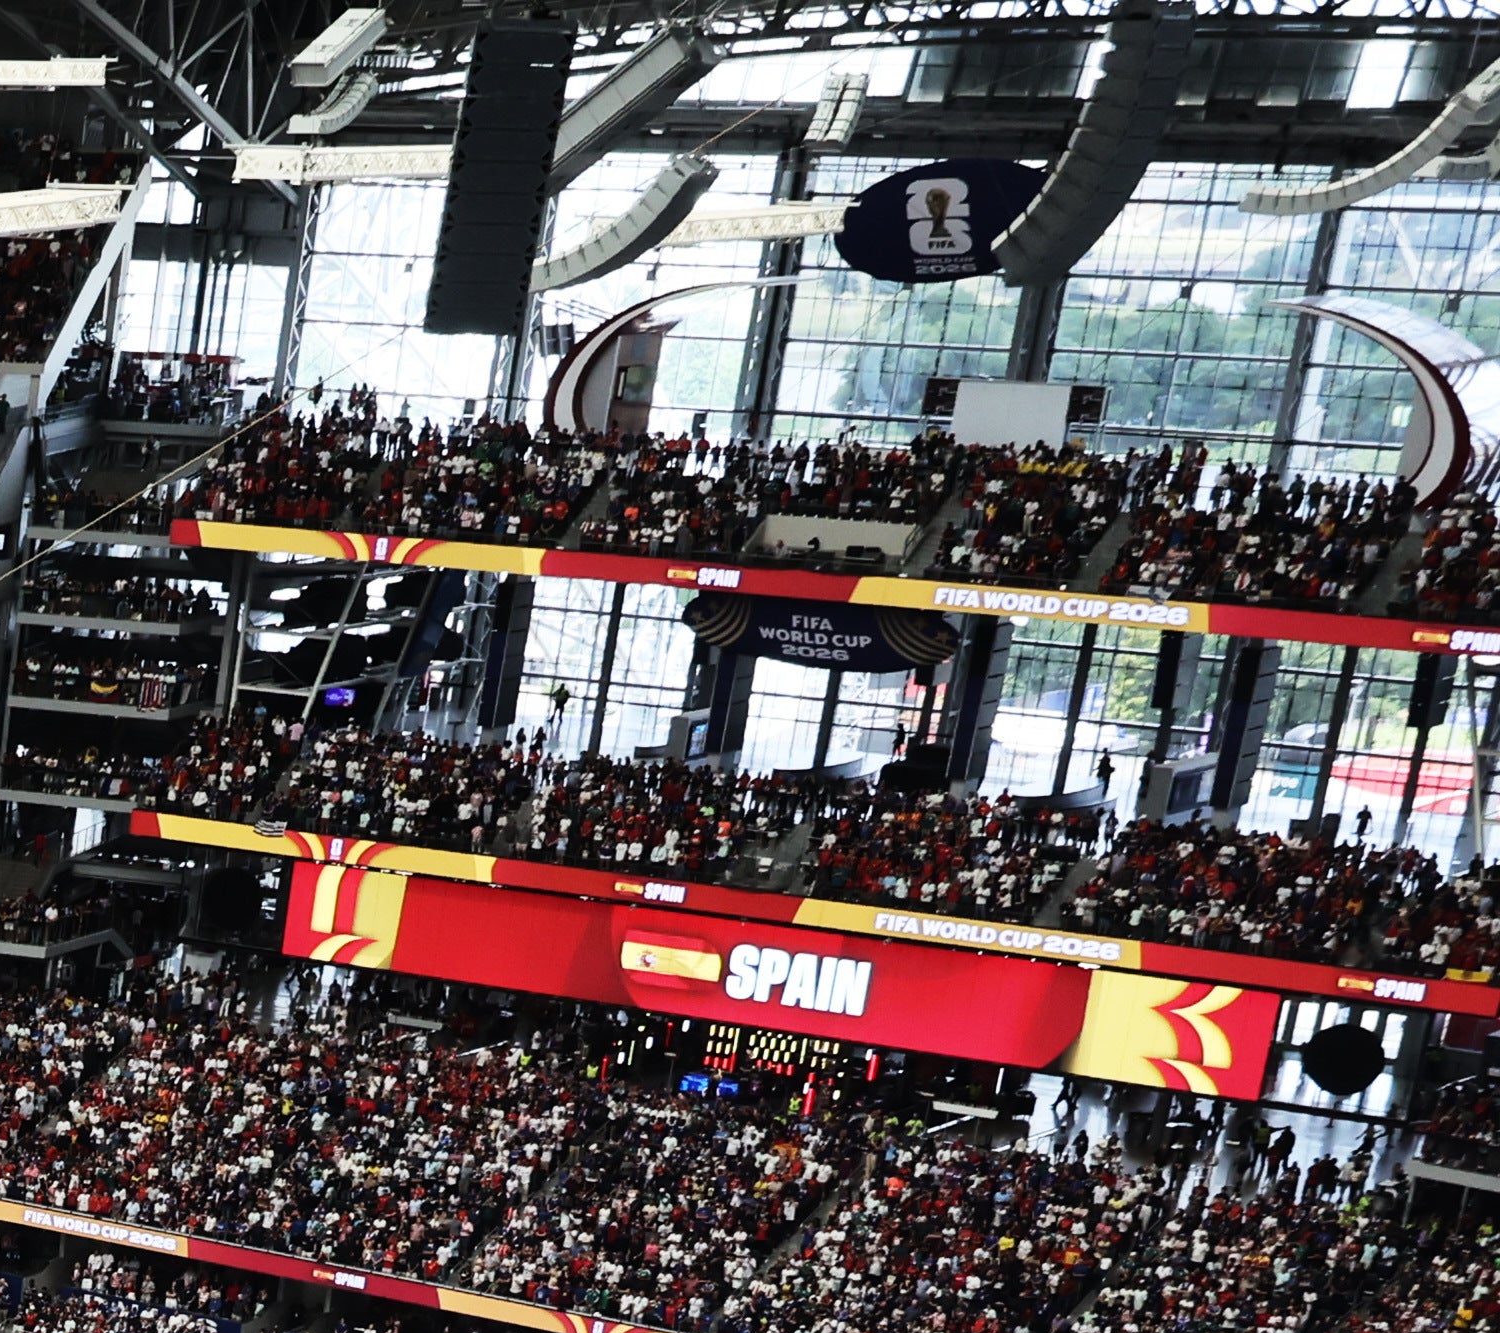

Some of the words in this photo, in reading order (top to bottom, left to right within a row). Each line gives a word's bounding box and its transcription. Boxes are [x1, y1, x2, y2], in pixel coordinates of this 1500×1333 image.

[697, 567, 741, 588] SPAIN
[934, 587, 980, 608] FIFA
[982, 591, 1061, 614] WORLD
[1063, 597, 1107, 617] CUP
[1108, 601, 1189, 625] 2026
[791, 614, 833, 631] FIFA
[760, 626, 828, 647] WORLD
[832, 634, 871, 649] CUP
[781, 644, 849, 661] 2026
[643, 882, 687, 904] SPAIN
[873, 913, 920, 934] FIFA
[921, 918, 997, 944] WORLD
[999, 926, 1042, 951] CUP
[1042, 934, 1121, 960] 2026
[725, 943, 873, 1017] SPAIN
[1375, 978, 1426, 1002] SPAIN
[23, 1210, 53, 1229] FIFA
[52, 1216, 104, 1236] WORLD
[103, 1225, 133, 1241] CUP
[132, 1231, 177, 1250] 2026
[335, 1272, 366, 1290] SPAIN
